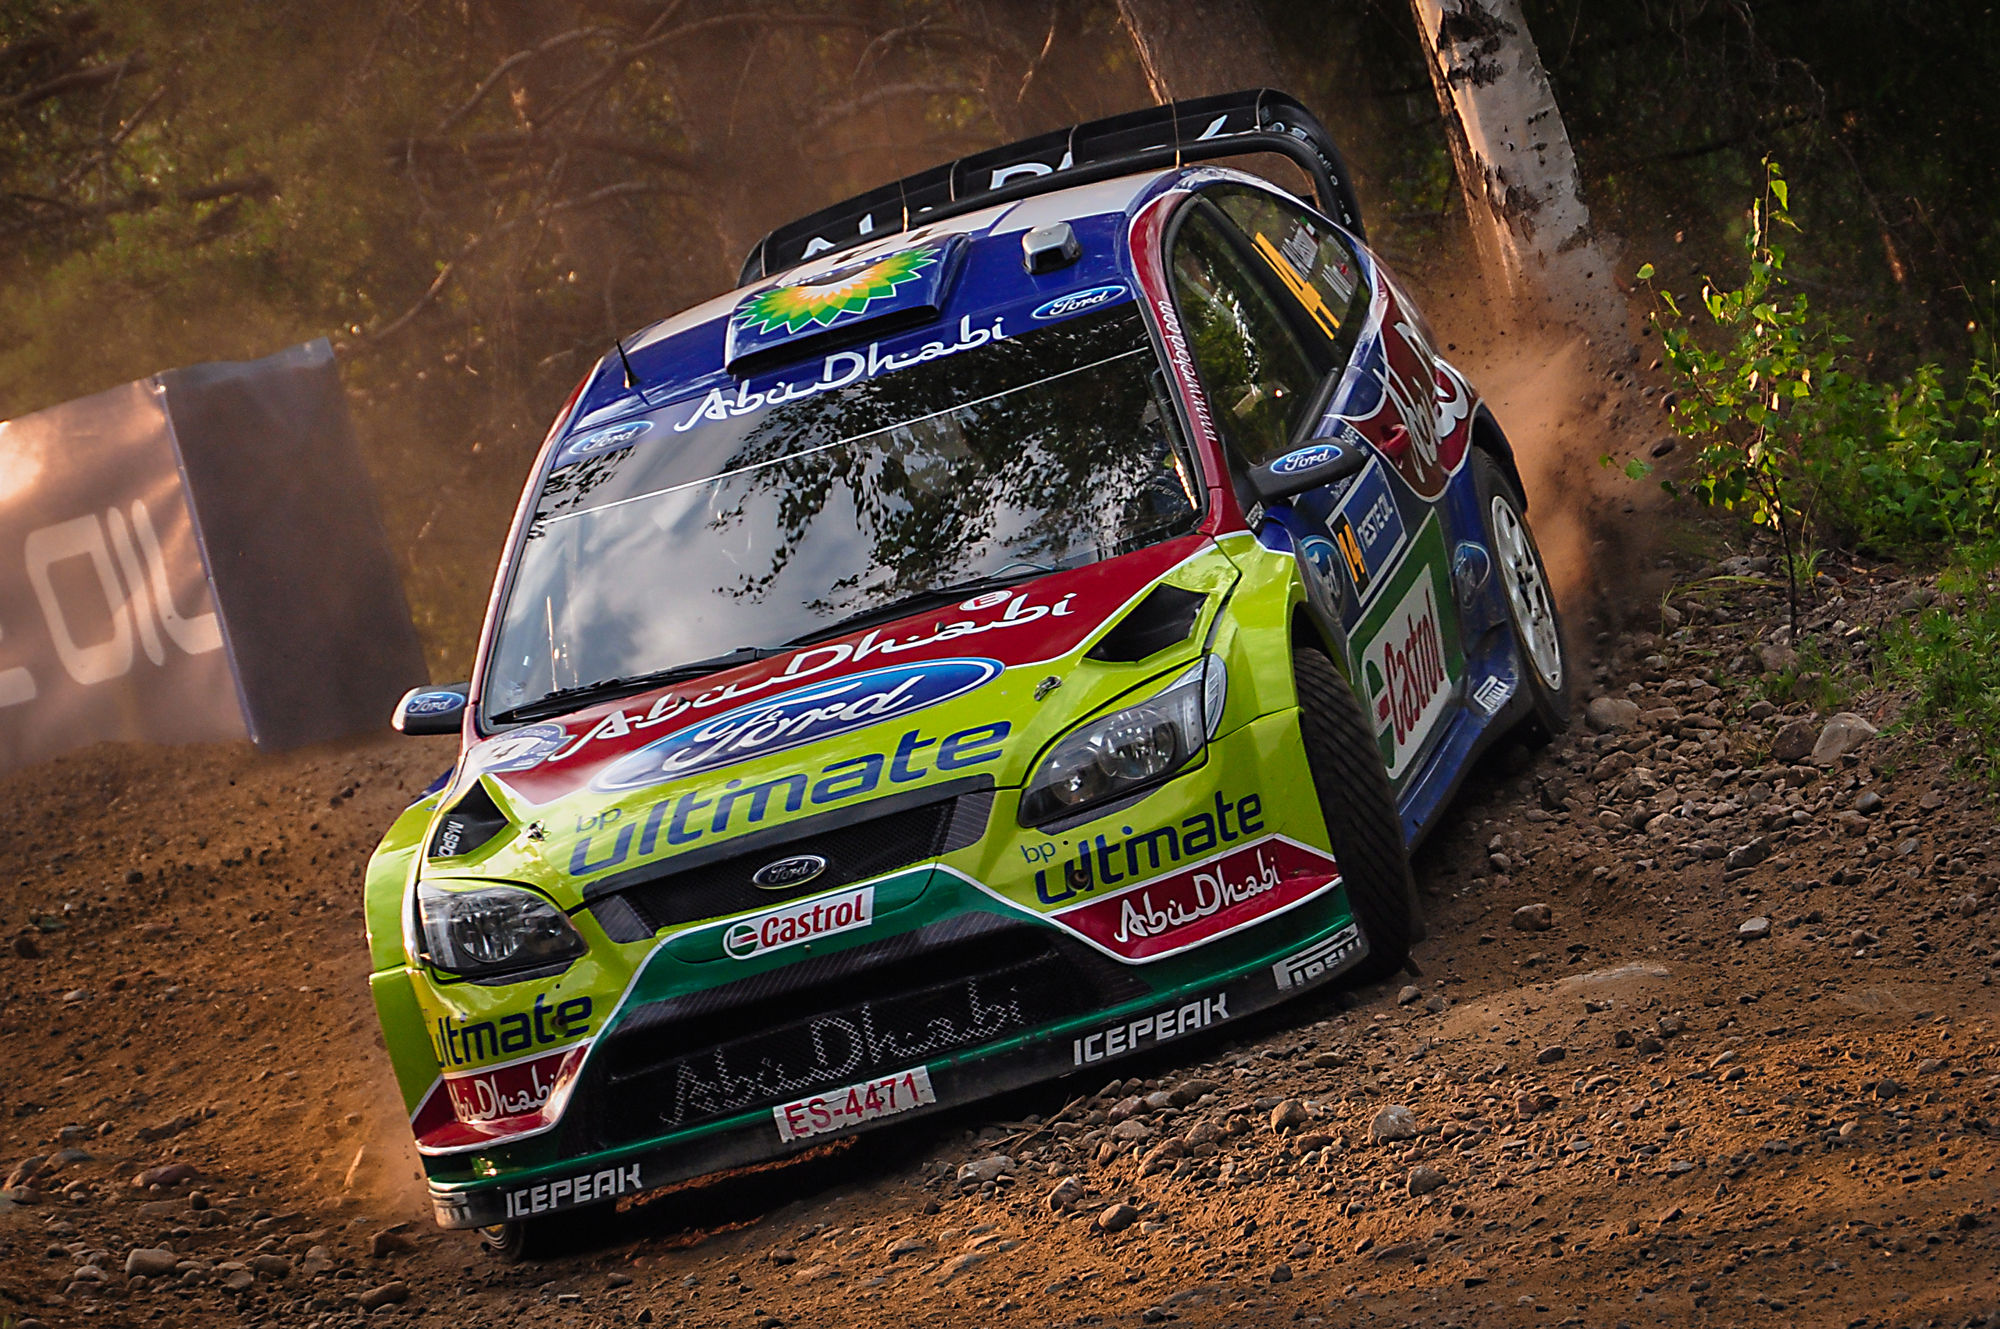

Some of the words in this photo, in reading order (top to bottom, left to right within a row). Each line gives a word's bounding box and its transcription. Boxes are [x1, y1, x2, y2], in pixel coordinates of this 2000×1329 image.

[1050, 289, 1108, 315] Ford
[582, 426, 640, 451] Ford
[1284, 449, 1331, 471] Ford
[1338, 524, 1365, 582] 14
[25, 500, 223, 685] OIL
[1384, 588, 1444, 745] Castrol
[408, 695, 453, 713] Ford
[662, 674, 927, 773] Ford
[567, 721, 1013, 877] ultimate
[576, 808, 622, 833] bp
[768, 860, 808, 882] Ford
[1021, 839, 1056, 864] bp
[1035, 790, 1264, 904] ultimate
[761, 894, 865, 947] Castrol
[1073, 992, 1231, 1065] ICEPEAK
[784, 1072, 919, 1135] ES-4471
[506, 1163, 643, 1218] ICEPEAK
